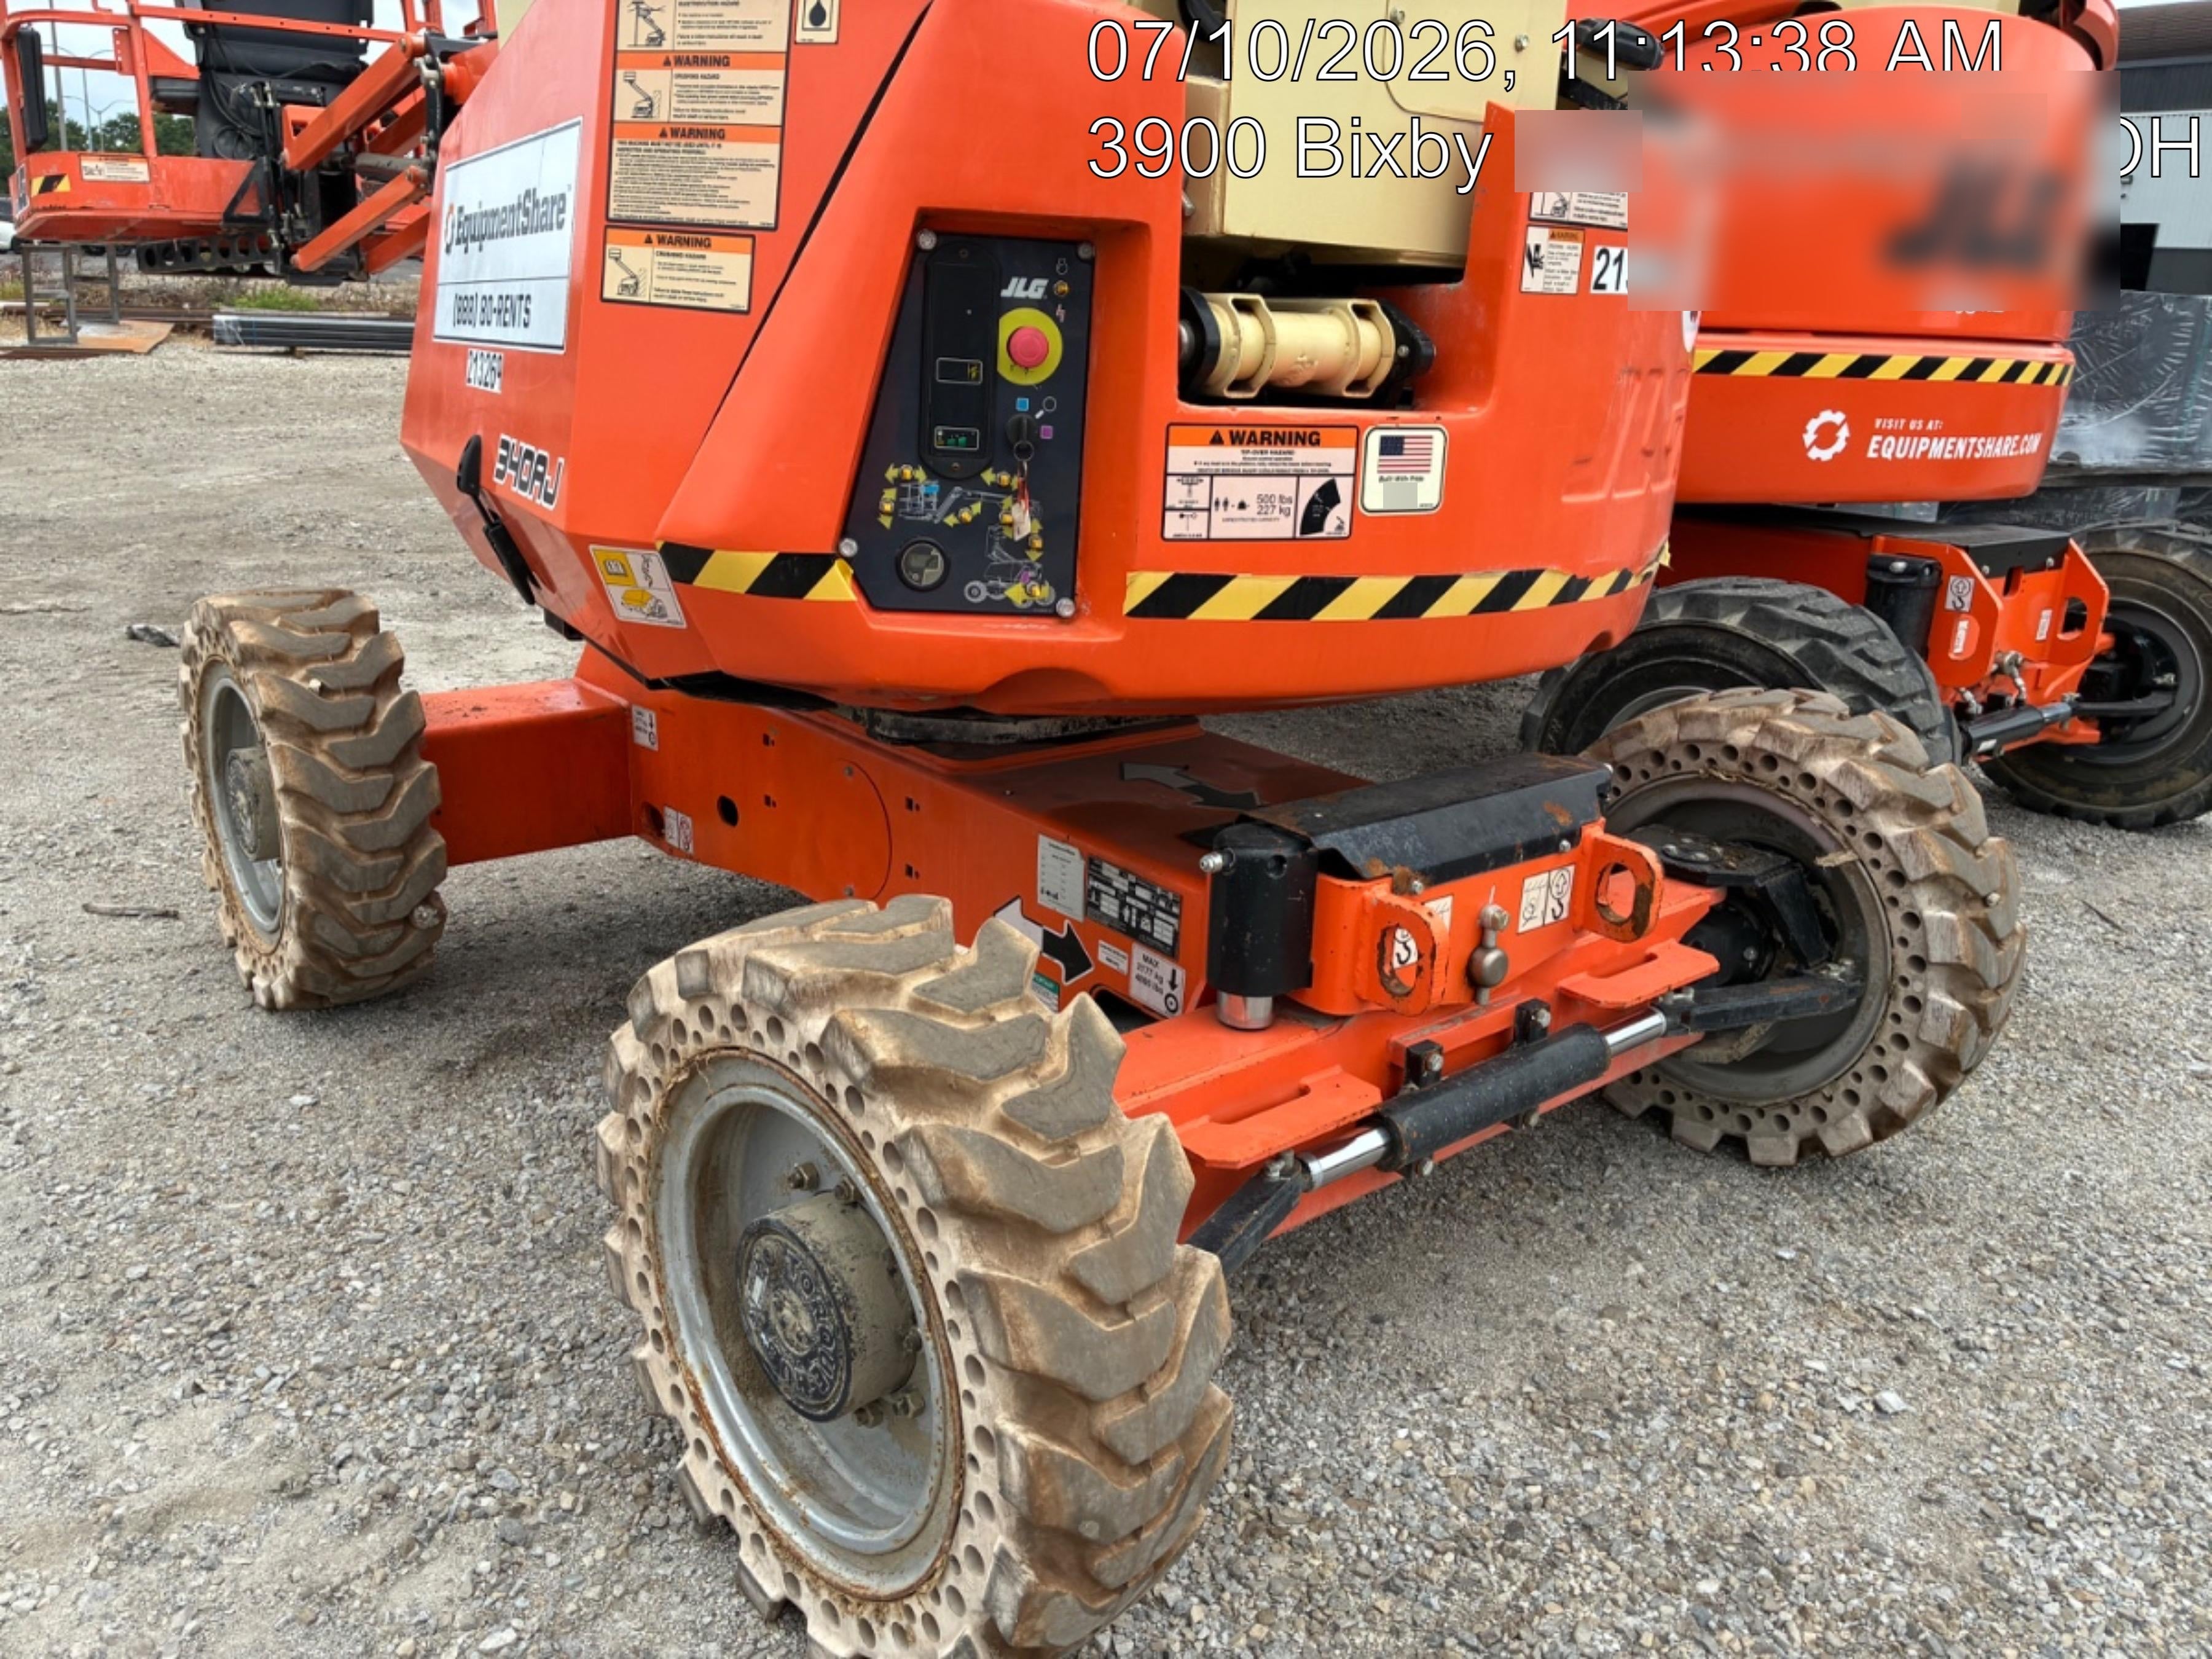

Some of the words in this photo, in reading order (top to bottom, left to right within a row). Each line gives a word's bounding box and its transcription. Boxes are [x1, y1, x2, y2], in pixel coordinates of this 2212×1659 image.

[673, 55, 730, 67] WARNING
[670, 127, 726, 139] WARNING
[455, 187, 567, 253] EquipmentShare
[656, 234, 712, 248] WARNING
[1593, 247, 1628, 291] 21
[1000, 276, 1049, 299] JLG
[453, 292, 478, 328] (888)
[479, 294, 531, 329] 80-RENTS
[1875, 418, 1905, 430] VISIT
[1910, 419, 1923, 430] US
[1926, 420, 1943, 431] AT:
[1229, 430, 1321, 447] WARNING
[1867, 433, 2043, 461] EQUIPMENTSHARE.COM
[494, 434, 564, 511] 340AJ
[1257, 494, 1276, 504] 500
[1279, 494, 1293, 504] lbs
[1257, 505, 1276, 515] 227
[1279, 505, 1292, 517] kg
